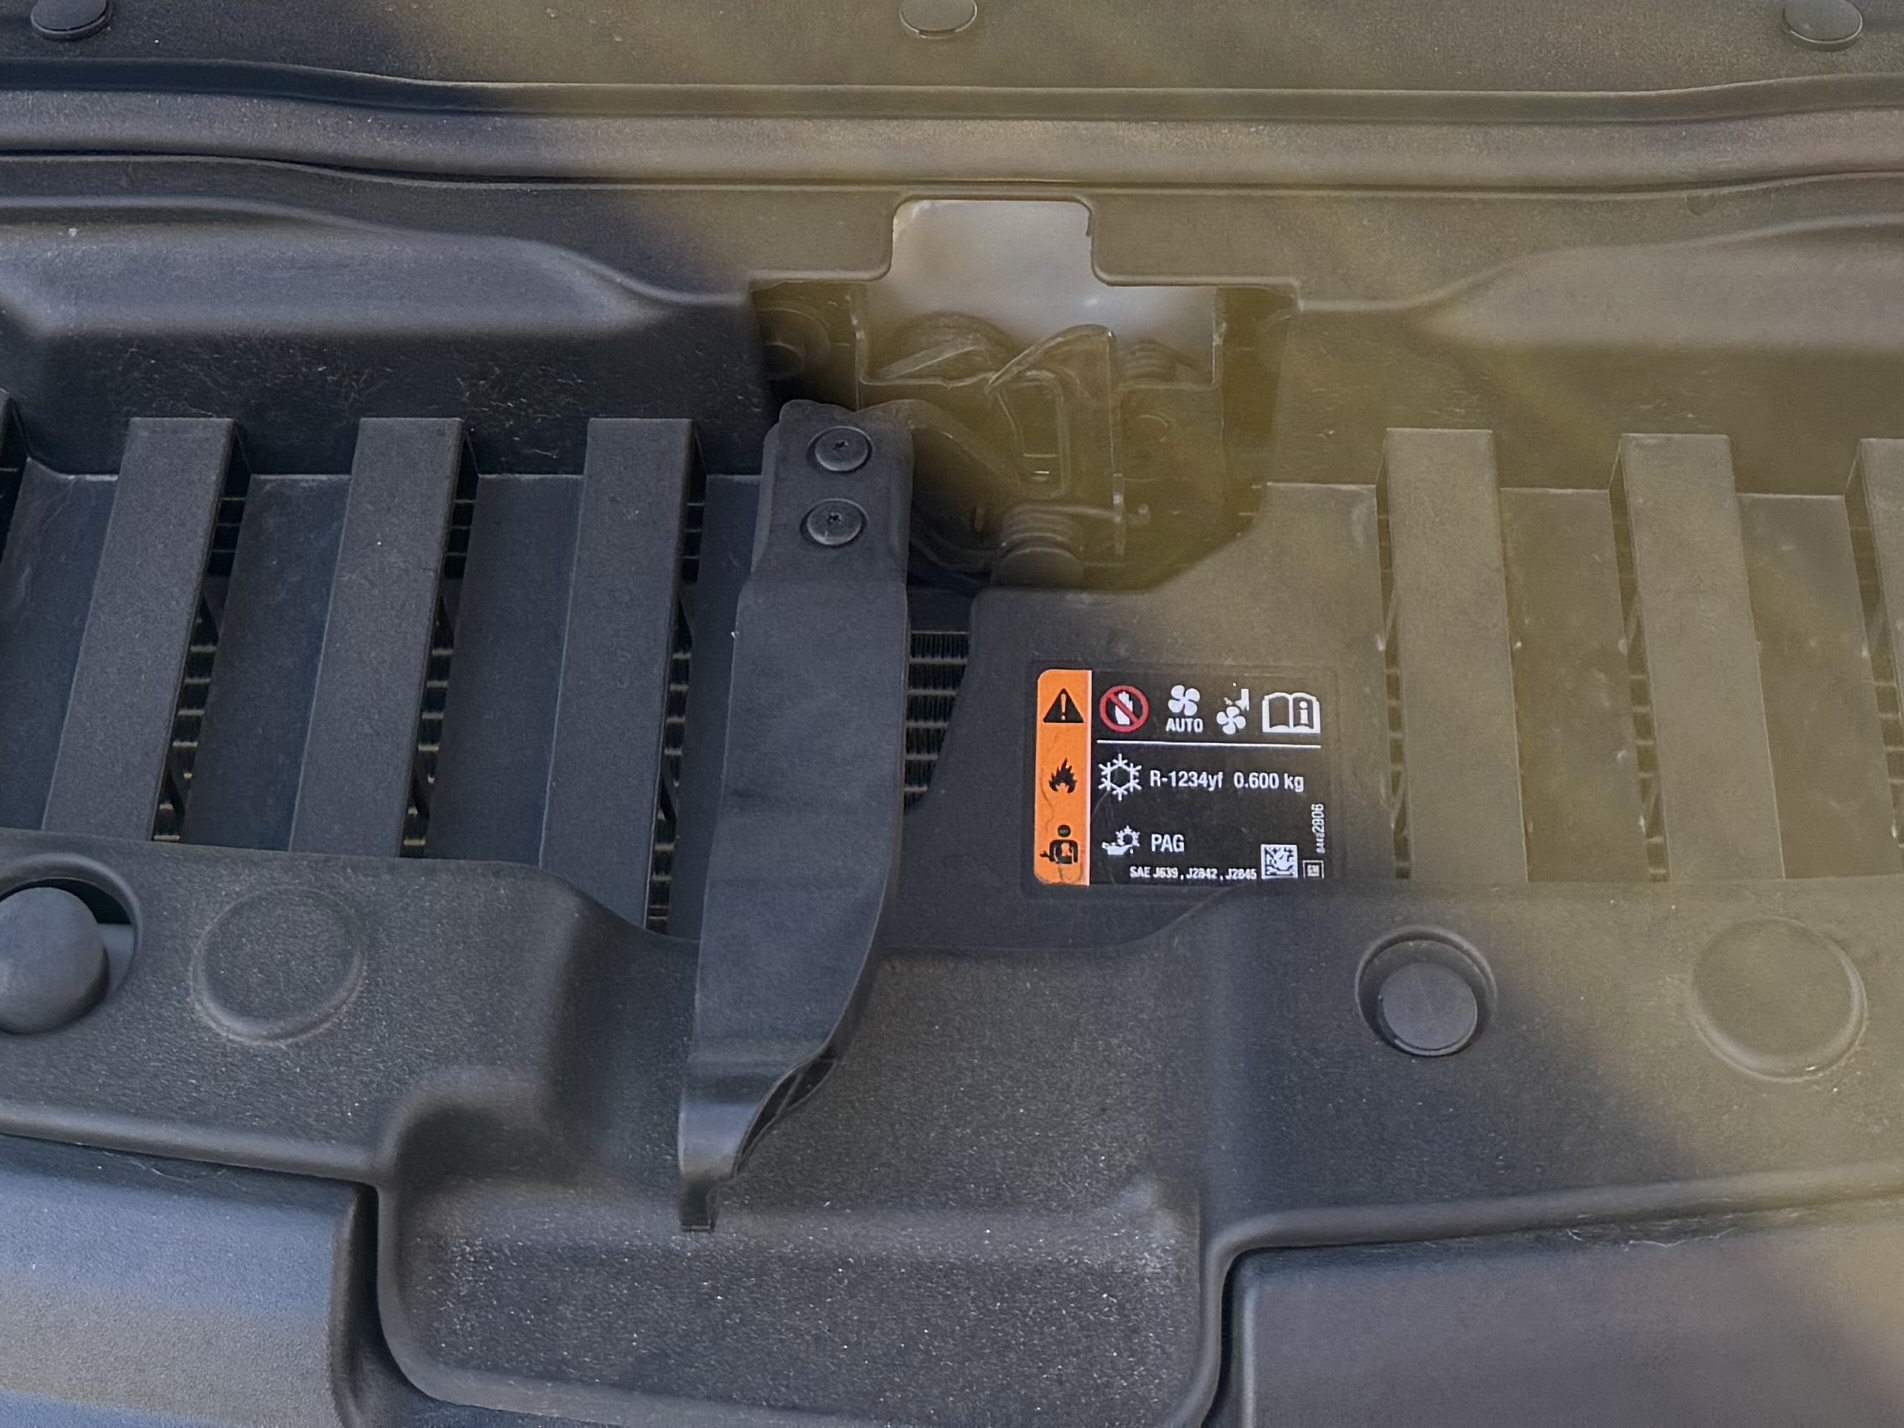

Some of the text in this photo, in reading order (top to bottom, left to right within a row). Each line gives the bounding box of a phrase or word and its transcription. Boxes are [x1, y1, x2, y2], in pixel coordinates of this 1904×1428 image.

[1165, 718, 1203, 733] AUTO
[1149, 771, 1304, 792] R-1234yf 0.600 kg
[1151, 834, 1185, 853] PAG
[1129, 865, 1151, 879] SAE
